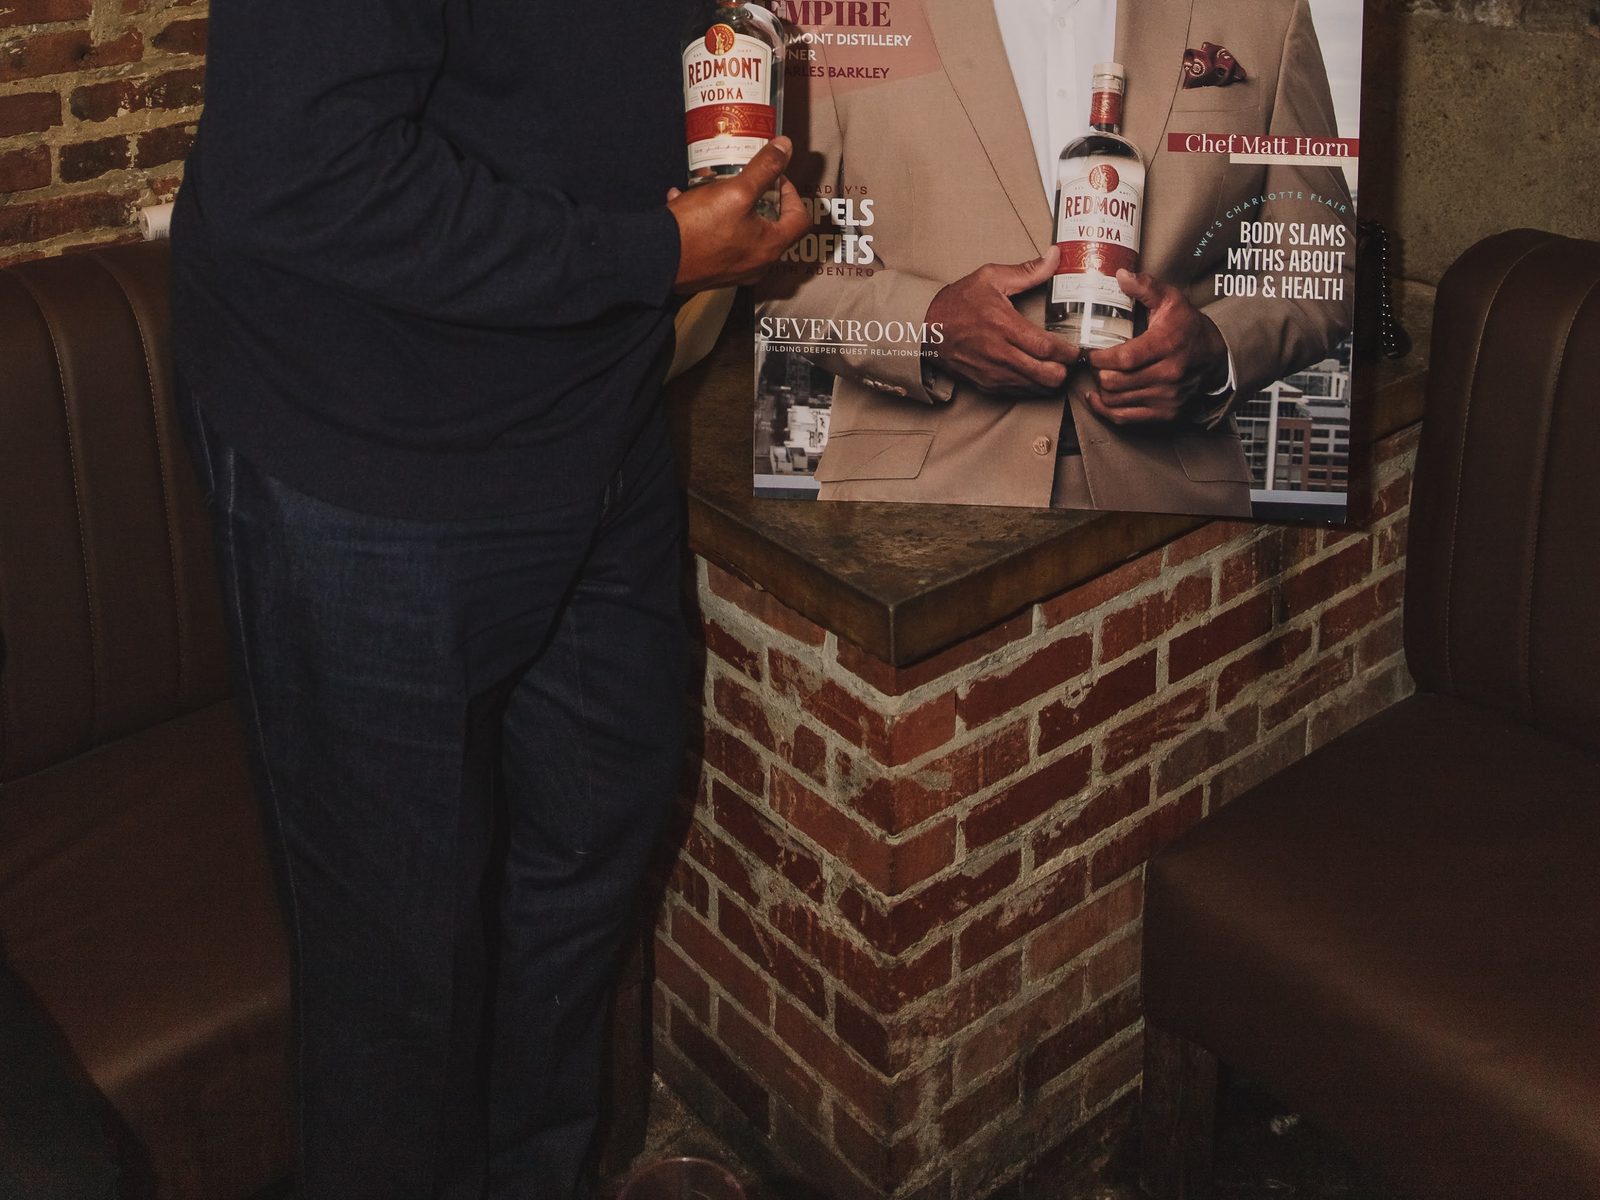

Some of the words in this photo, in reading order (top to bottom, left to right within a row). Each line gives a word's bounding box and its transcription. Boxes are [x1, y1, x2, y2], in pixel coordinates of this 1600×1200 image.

[836, 33, 912, 47] DISTILLERY
[688, 57, 762, 88] REDMONT
[828, 66, 890, 79] BARKLEY
[700, 87, 744, 103] VODKA
[1185, 133, 1236, 153] Chef
[1241, 135, 1288, 155] Matt
[1295, 137, 1349, 157] Horn
[1065, 195, 1137, 226] REDMONT
[1078, 225, 1121, 242] VODKA
[1193, 220, 1222, 257] WWE'S
[1226, 191, 1303, 219] CHARLOTTE
[1310, 193, 1347, 214] FLAIR
[1240, 221, 1285, 245] BODY
[1288, 222, 1346, 247] SLAMS
[1227, 247, 1285, 271] MYTHS
[1289, 249, 1346, 274] ABOUT
[1214, 274, 1257, 297] FOOD
[1262, 275, 1276, 299] &
[1281, 276, 1344, 300] HEALTH
[760, 316, 944, 344] SEVENROOMS
[760, 345, 801, 354] BUILDING
[804, 346, 836, 355] DEEPER
[839, 347, 868, 356] GUEST
[870, 348, 939, 358] RELATIONSHIPS
